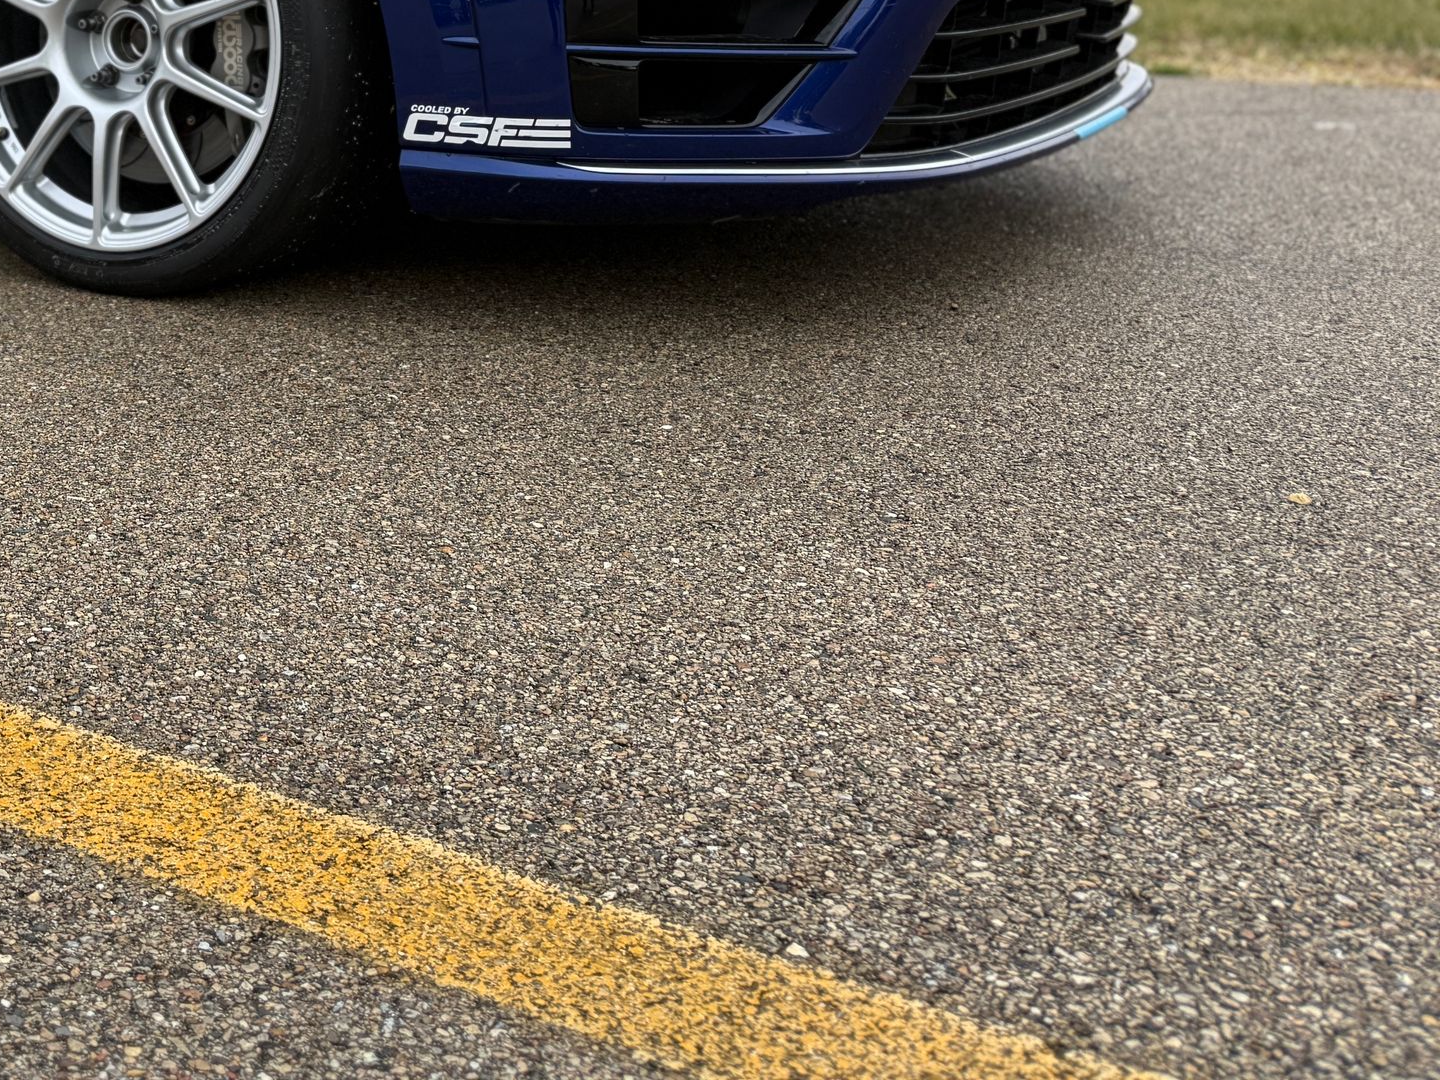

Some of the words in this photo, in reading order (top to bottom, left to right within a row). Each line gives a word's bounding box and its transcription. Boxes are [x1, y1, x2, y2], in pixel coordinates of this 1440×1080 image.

[410, 104, 451, 115] COOLED
[453, 106, 470, 115] BY
[402, 113, 572, 149] CSF
